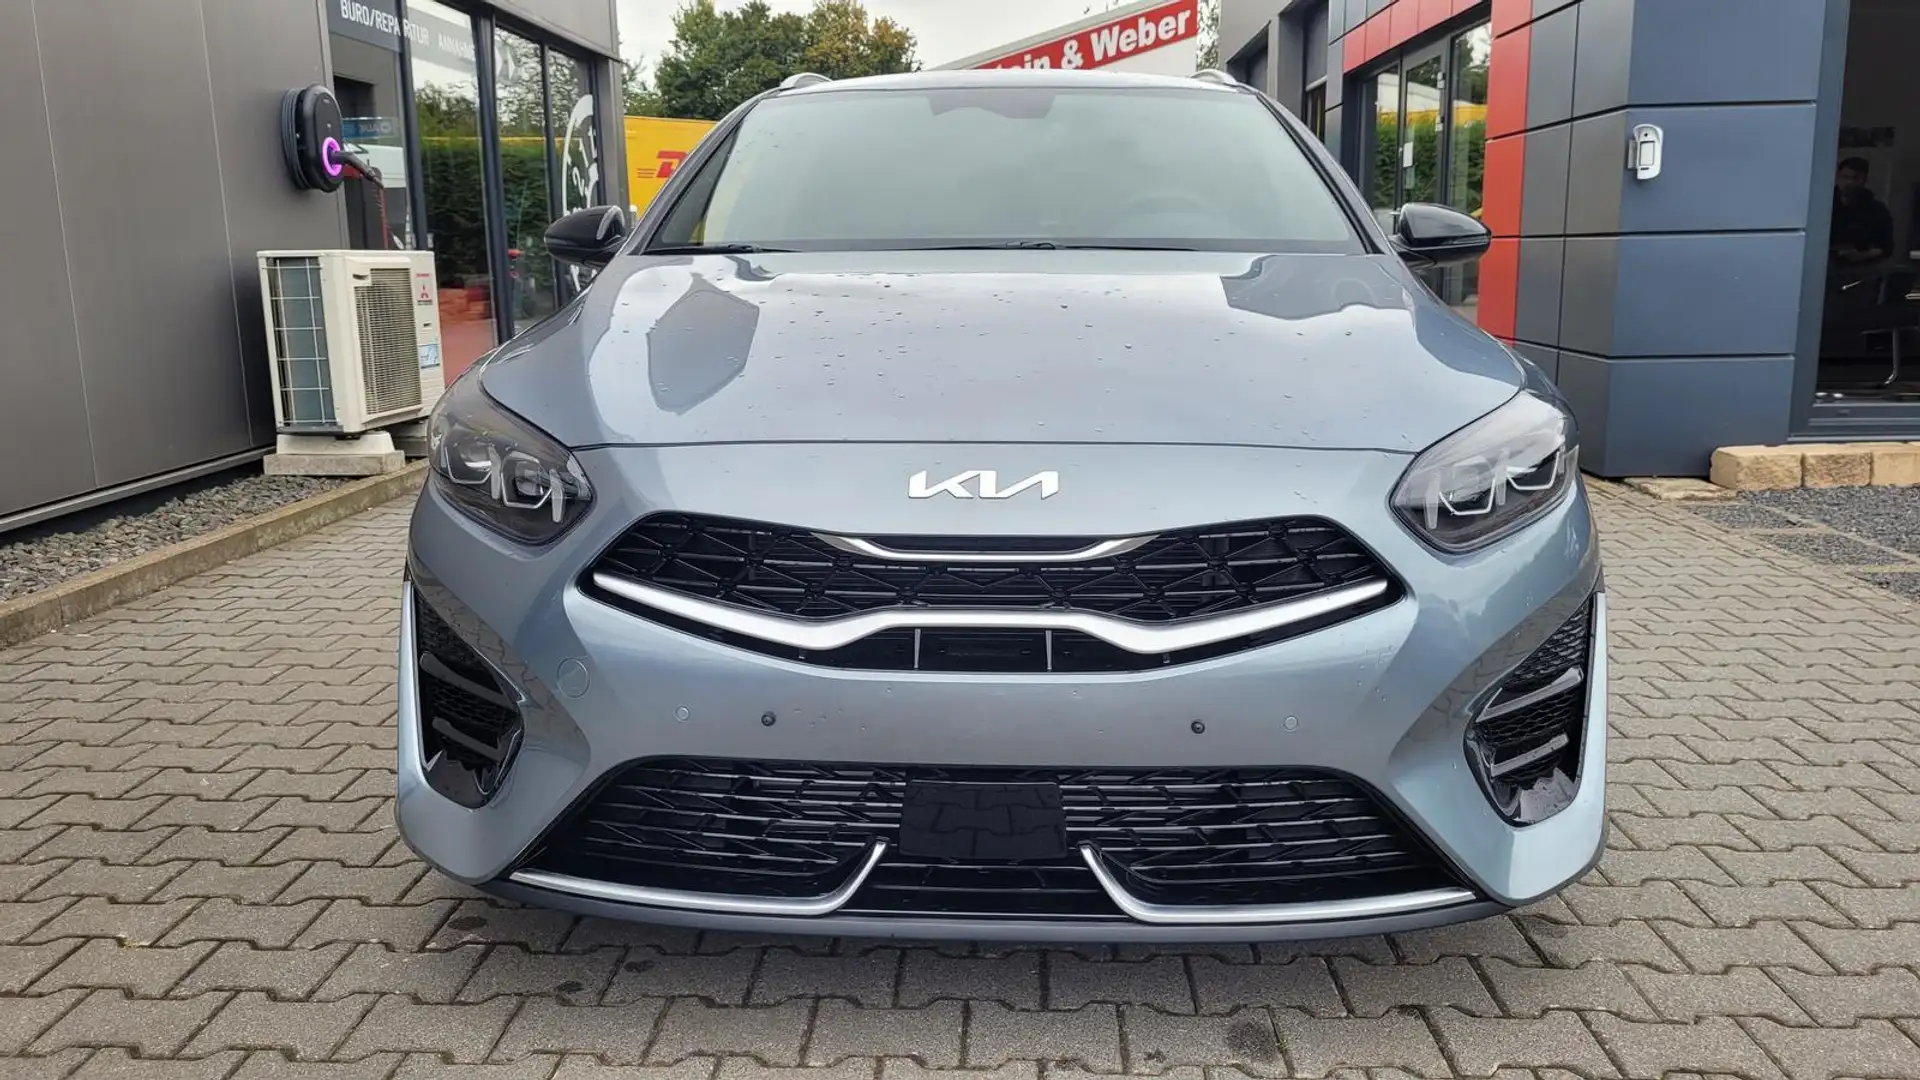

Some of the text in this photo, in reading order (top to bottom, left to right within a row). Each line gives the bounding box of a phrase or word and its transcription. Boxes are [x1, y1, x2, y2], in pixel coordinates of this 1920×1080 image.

[1061, 39, 1084, 69] &
[1090, 9, 1191, 62] Weber
[908, 469, 1059, 500] KIA
